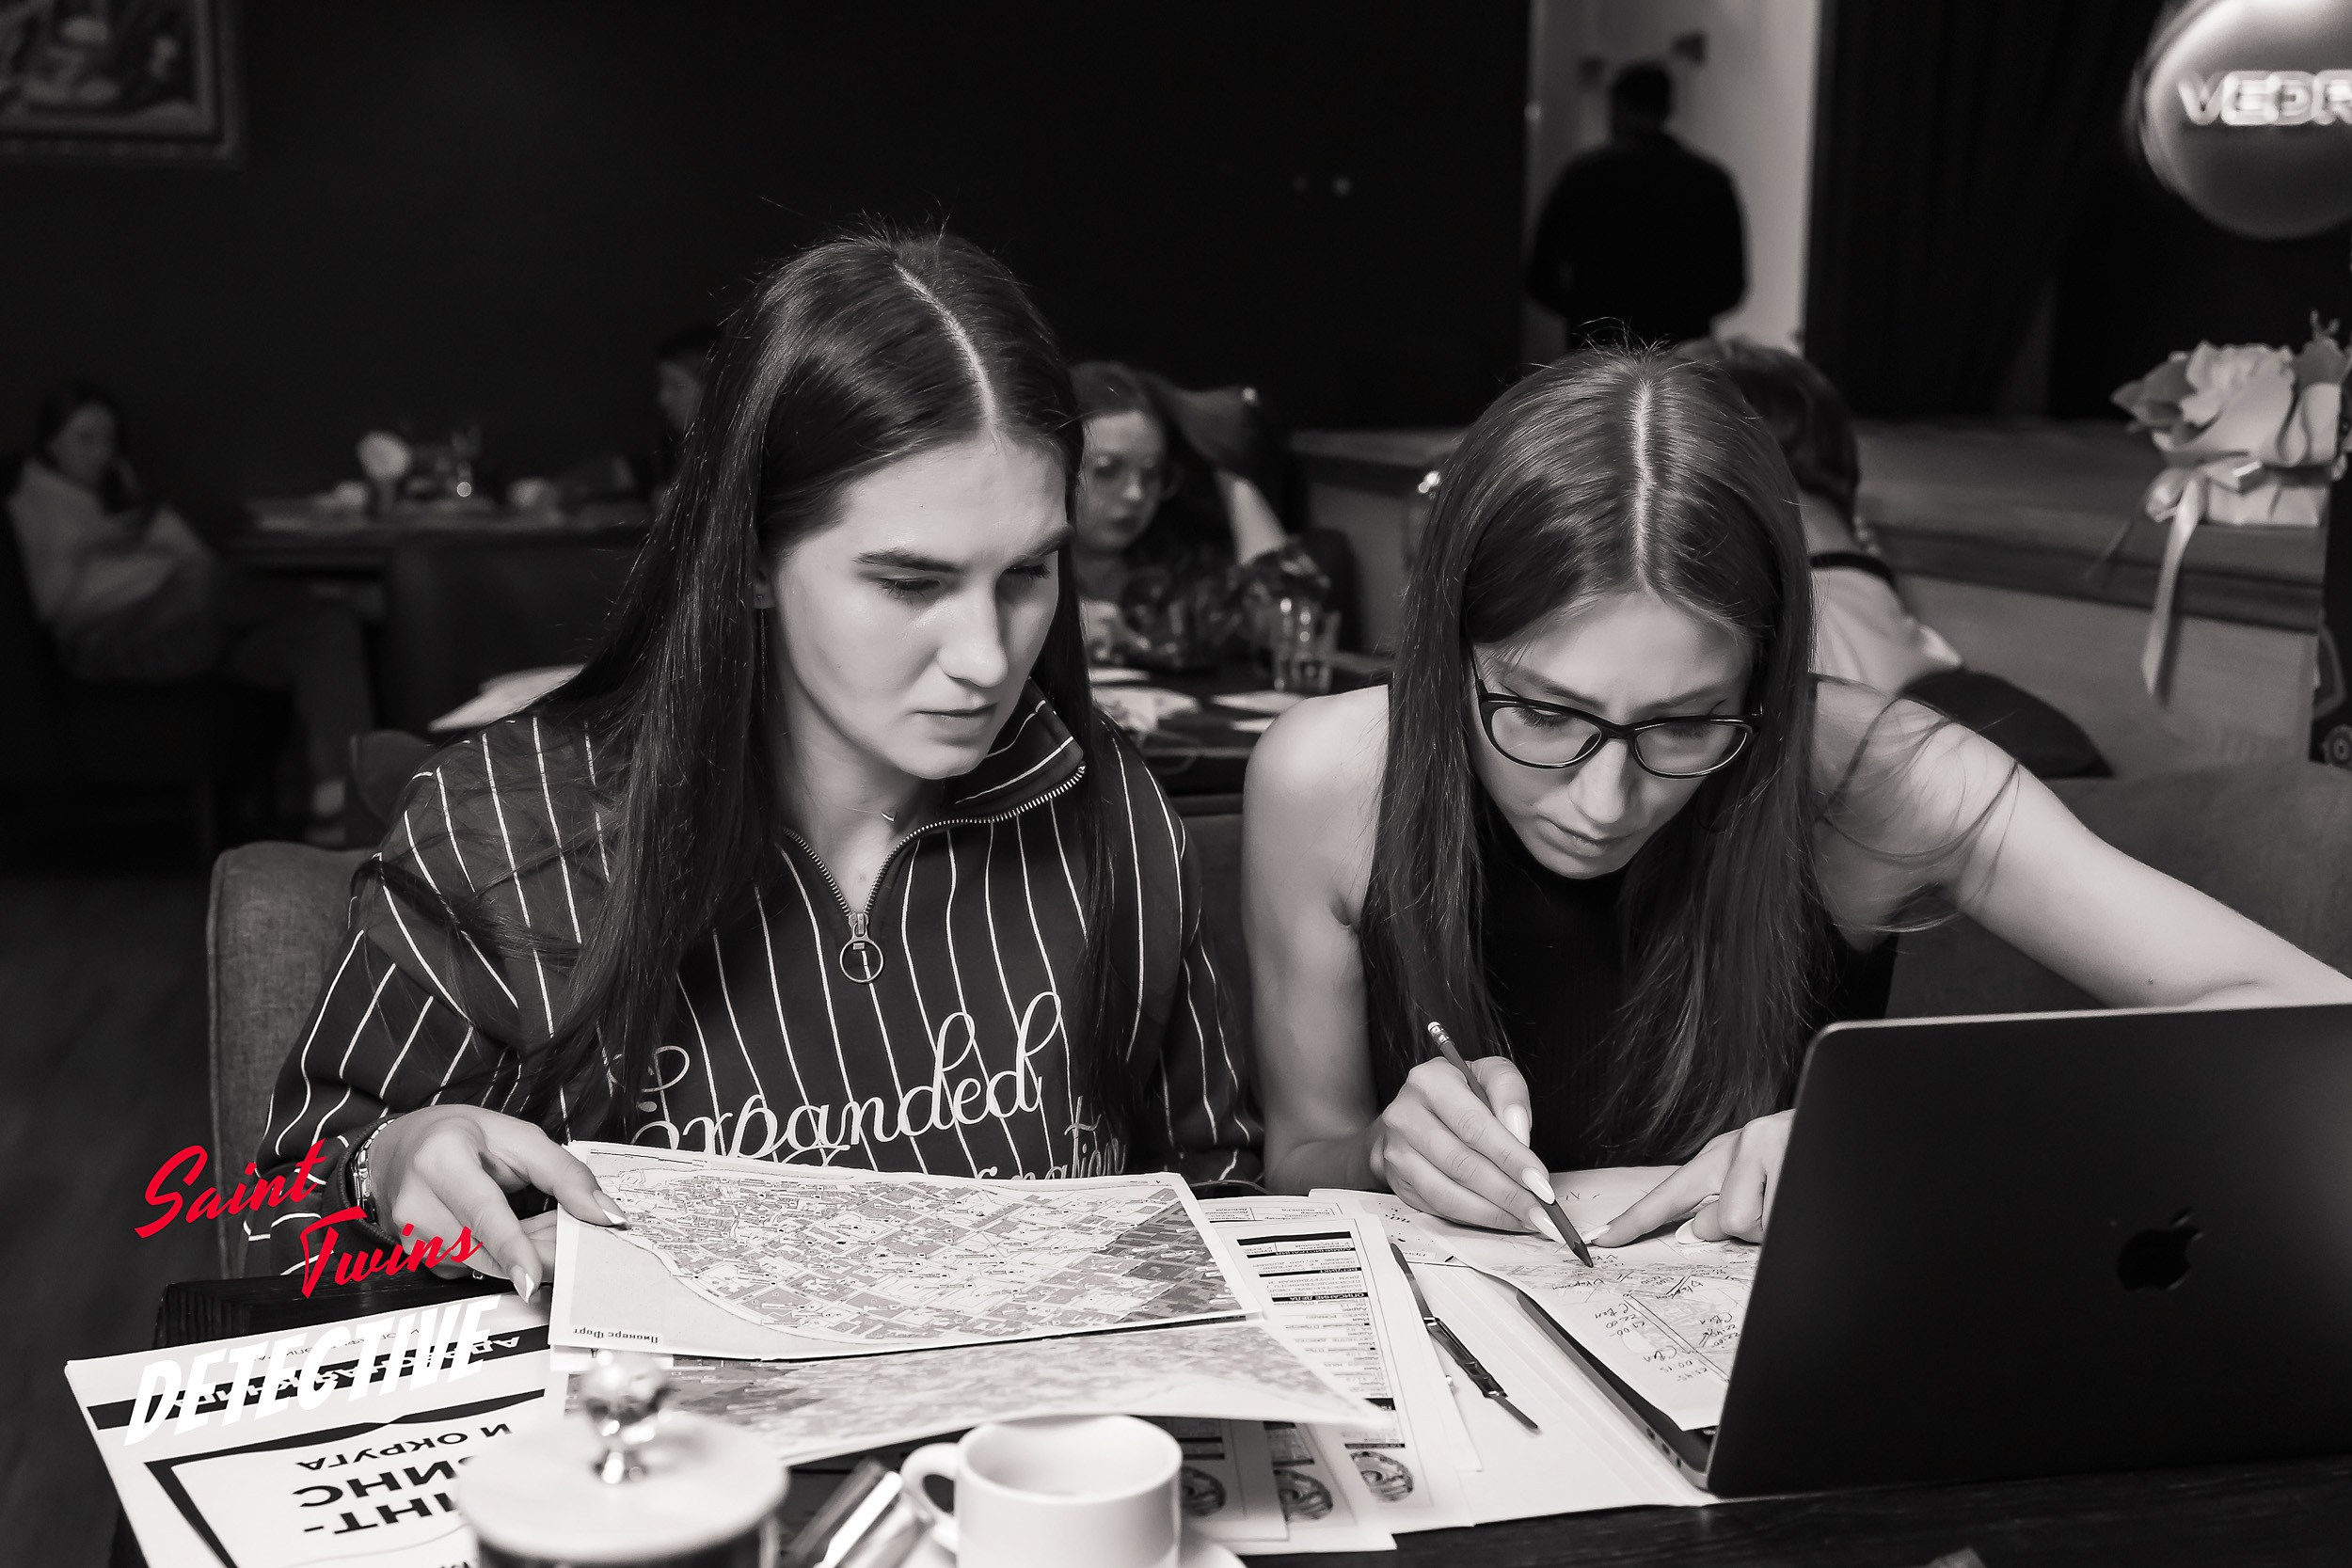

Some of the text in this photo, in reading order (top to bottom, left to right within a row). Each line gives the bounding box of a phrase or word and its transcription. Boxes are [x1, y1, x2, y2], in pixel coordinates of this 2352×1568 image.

[573, 1327, 659, 1344] Пионерс Форт
[296, 1423, 513, 1470] И ОКРУГА
[292, 1456, 475, 1507] ИНС
